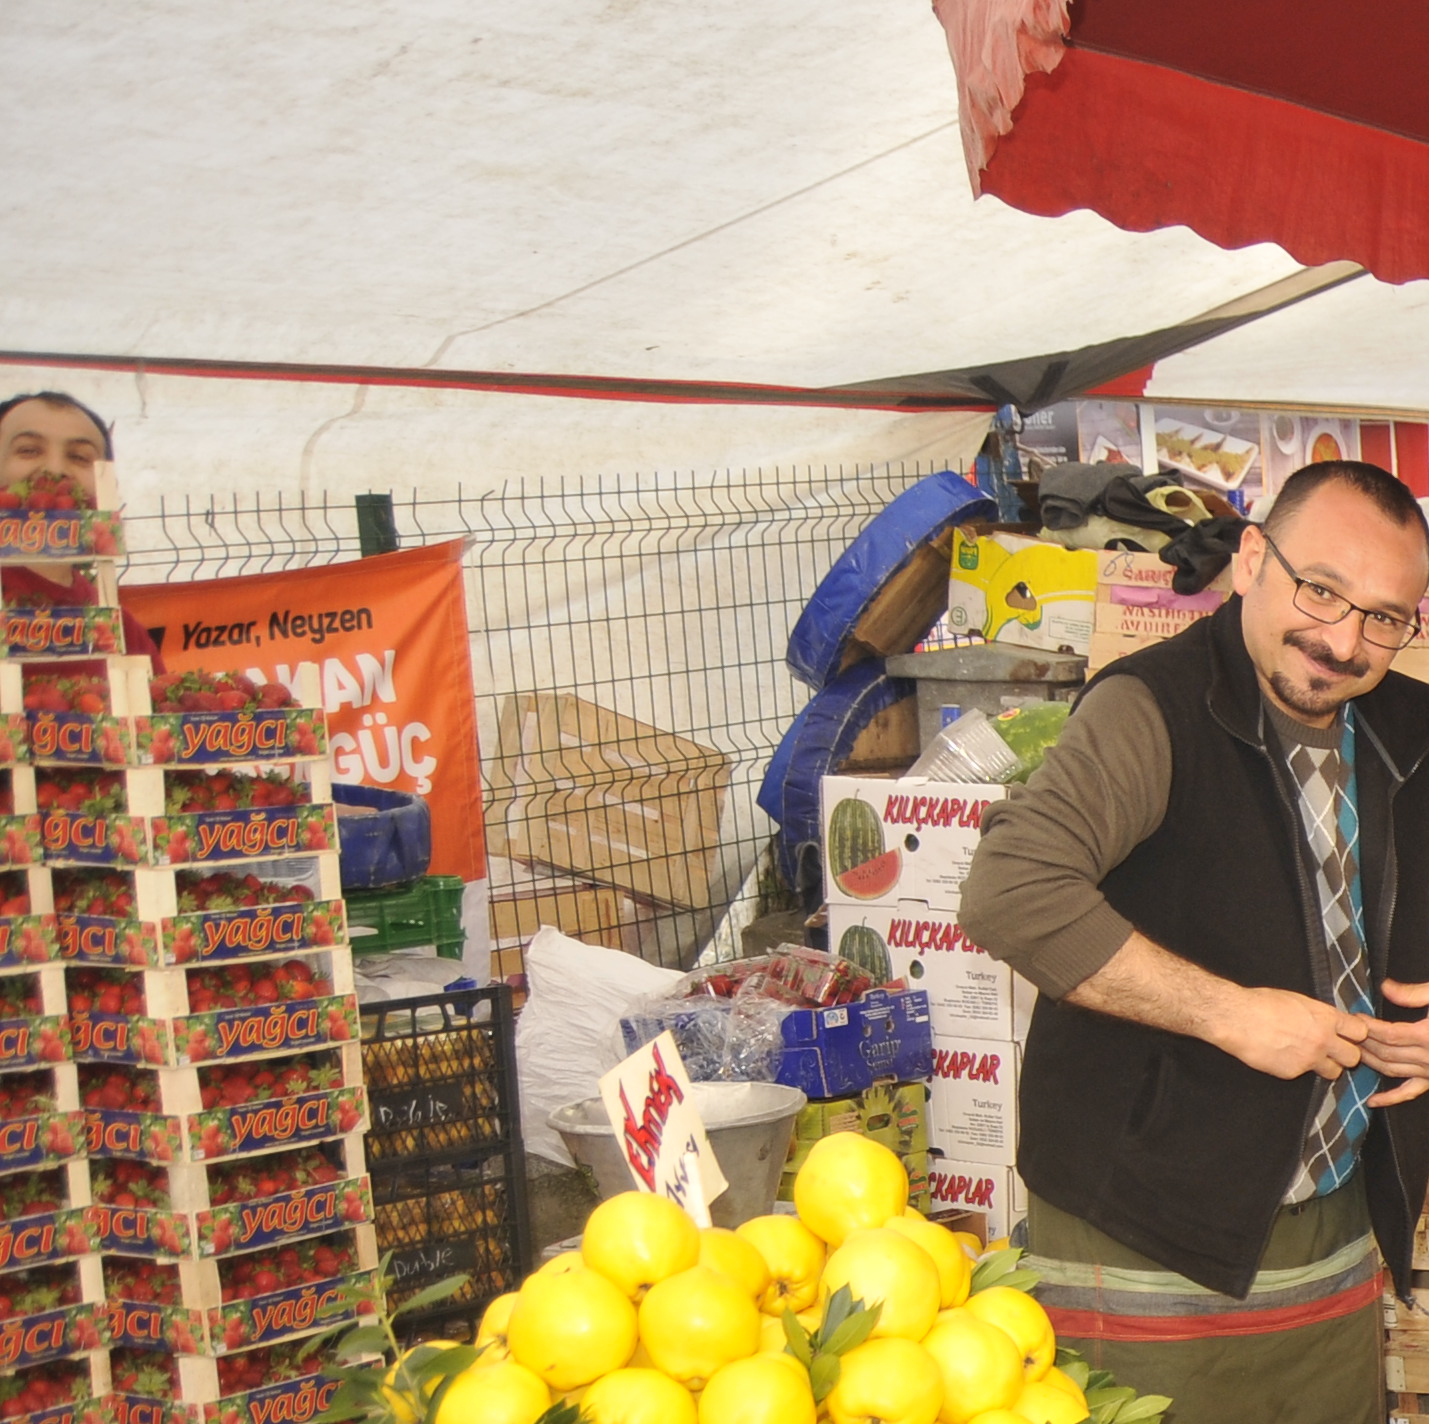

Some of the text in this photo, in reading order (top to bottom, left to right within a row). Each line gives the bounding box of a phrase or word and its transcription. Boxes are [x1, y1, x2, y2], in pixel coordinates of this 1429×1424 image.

[0, 511, 80, 552] ağcı
[6, 609, 84, 650] ağcı
[181, 606, 374, 652] Yazar, Neyzen
[32, 712, 92, 753] ğcı
[182, 713, 287, 759] yağcı
[44, 810, 107, 849] ğcı
[197, 812, 298, 859] yağcı
[60, 915, 116, 956] ğcı
[203, 907, 303, 955] yağcı
[887, 918, 986, 957] KILIÇKAP
[965, 970, 998, 984] Turkey
[70, 1009, 128, 1053] ğcı
[217, 1005, 318, 1055] yağcı
[926, 1048, 1001, 1086] KAPLAR
[231, 1096, 328, 1148] yağcı
[971, 1098, 1003, 1111] Turkey
[84, 1112, 141, 1151] ğcı
[241, 1190, 335, 1242] yağcı
[0, 1321, 66, 1363] ğcı
